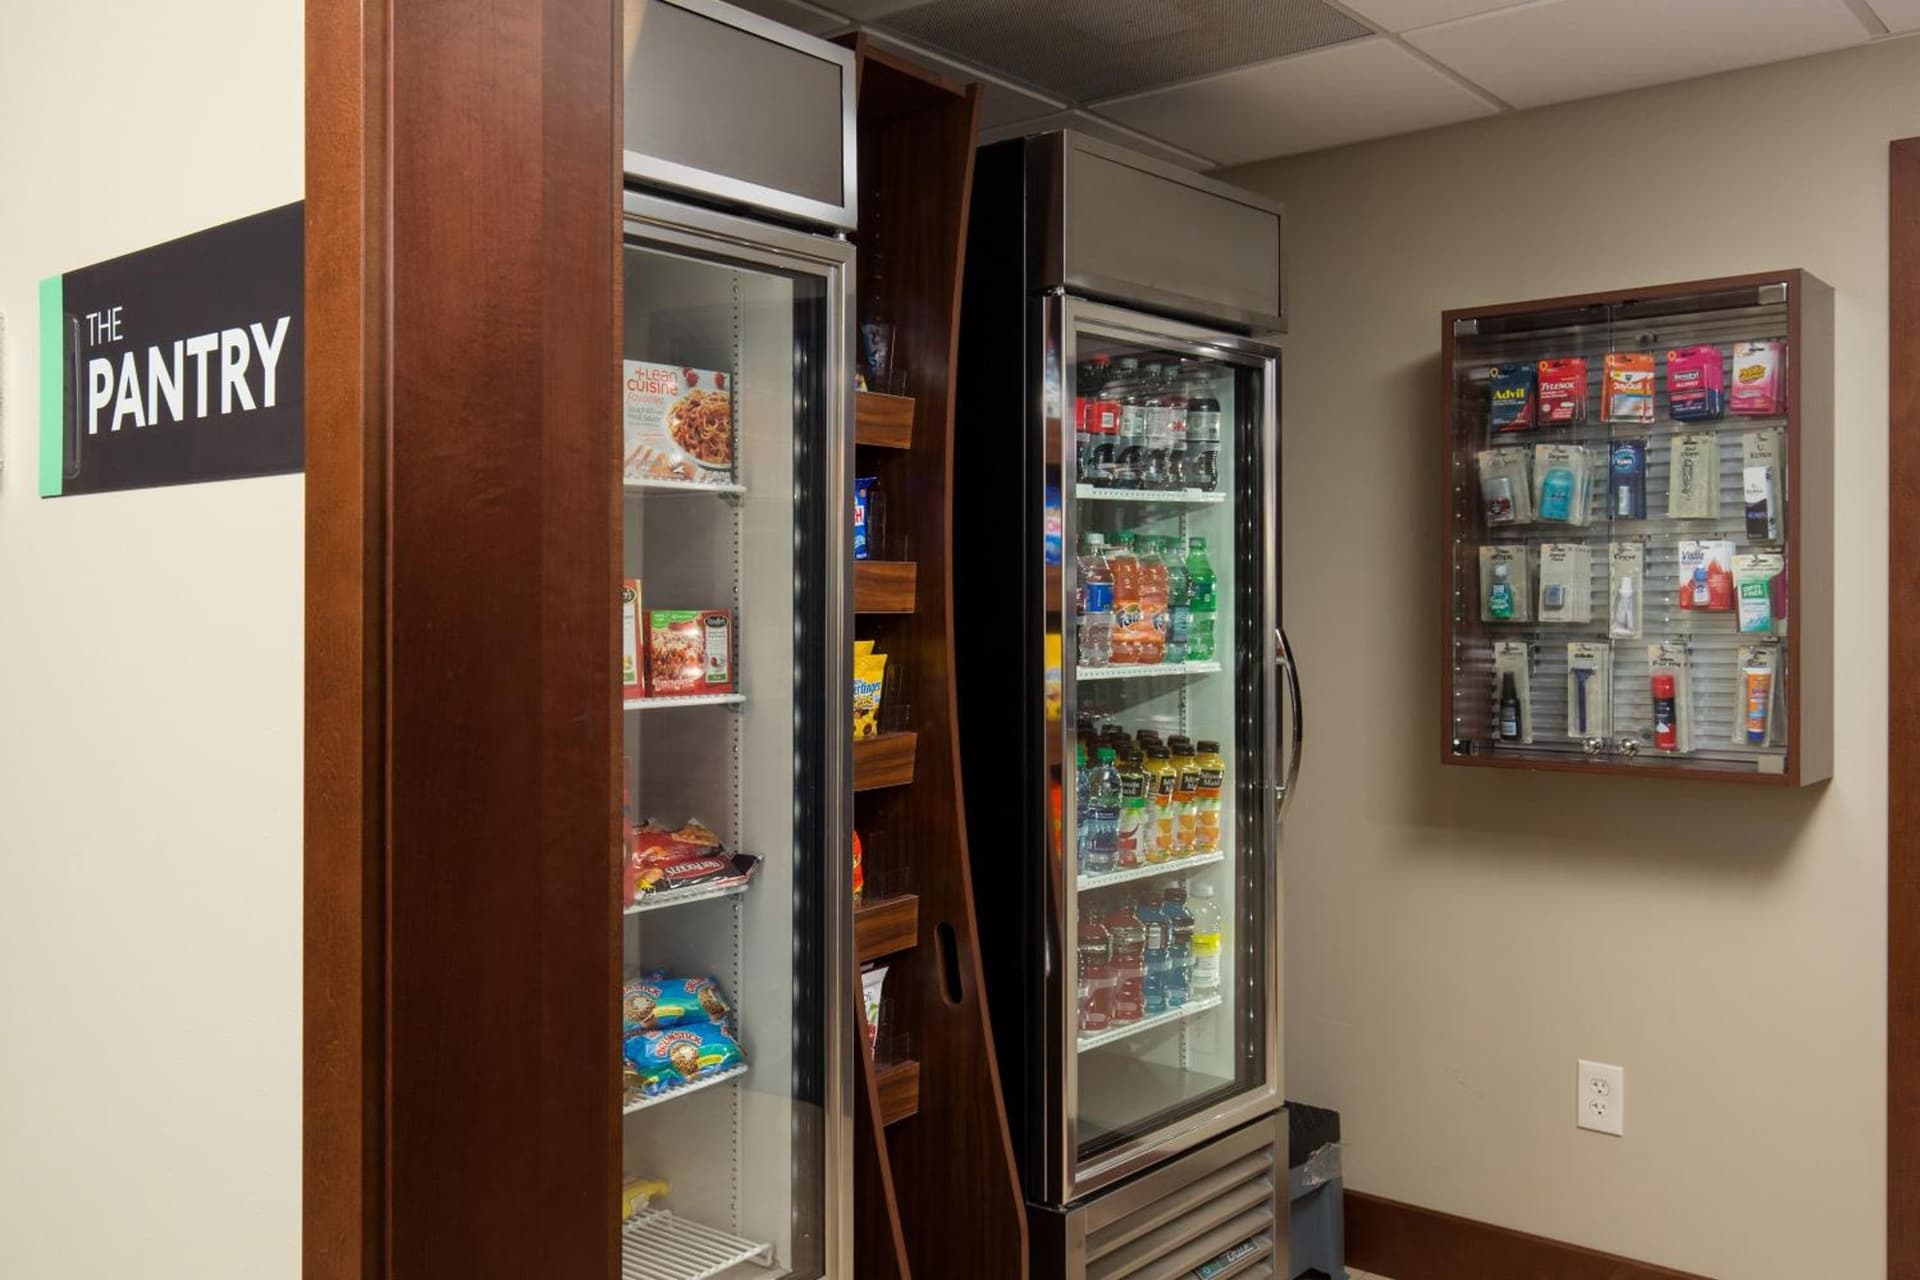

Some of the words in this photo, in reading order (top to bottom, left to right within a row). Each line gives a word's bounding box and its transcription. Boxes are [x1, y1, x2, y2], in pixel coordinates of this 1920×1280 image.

[86, 306, 123, 347] THE
[88, 315, 291, 435] PANTRY
[1494, 387, 1525, 400] Advil
